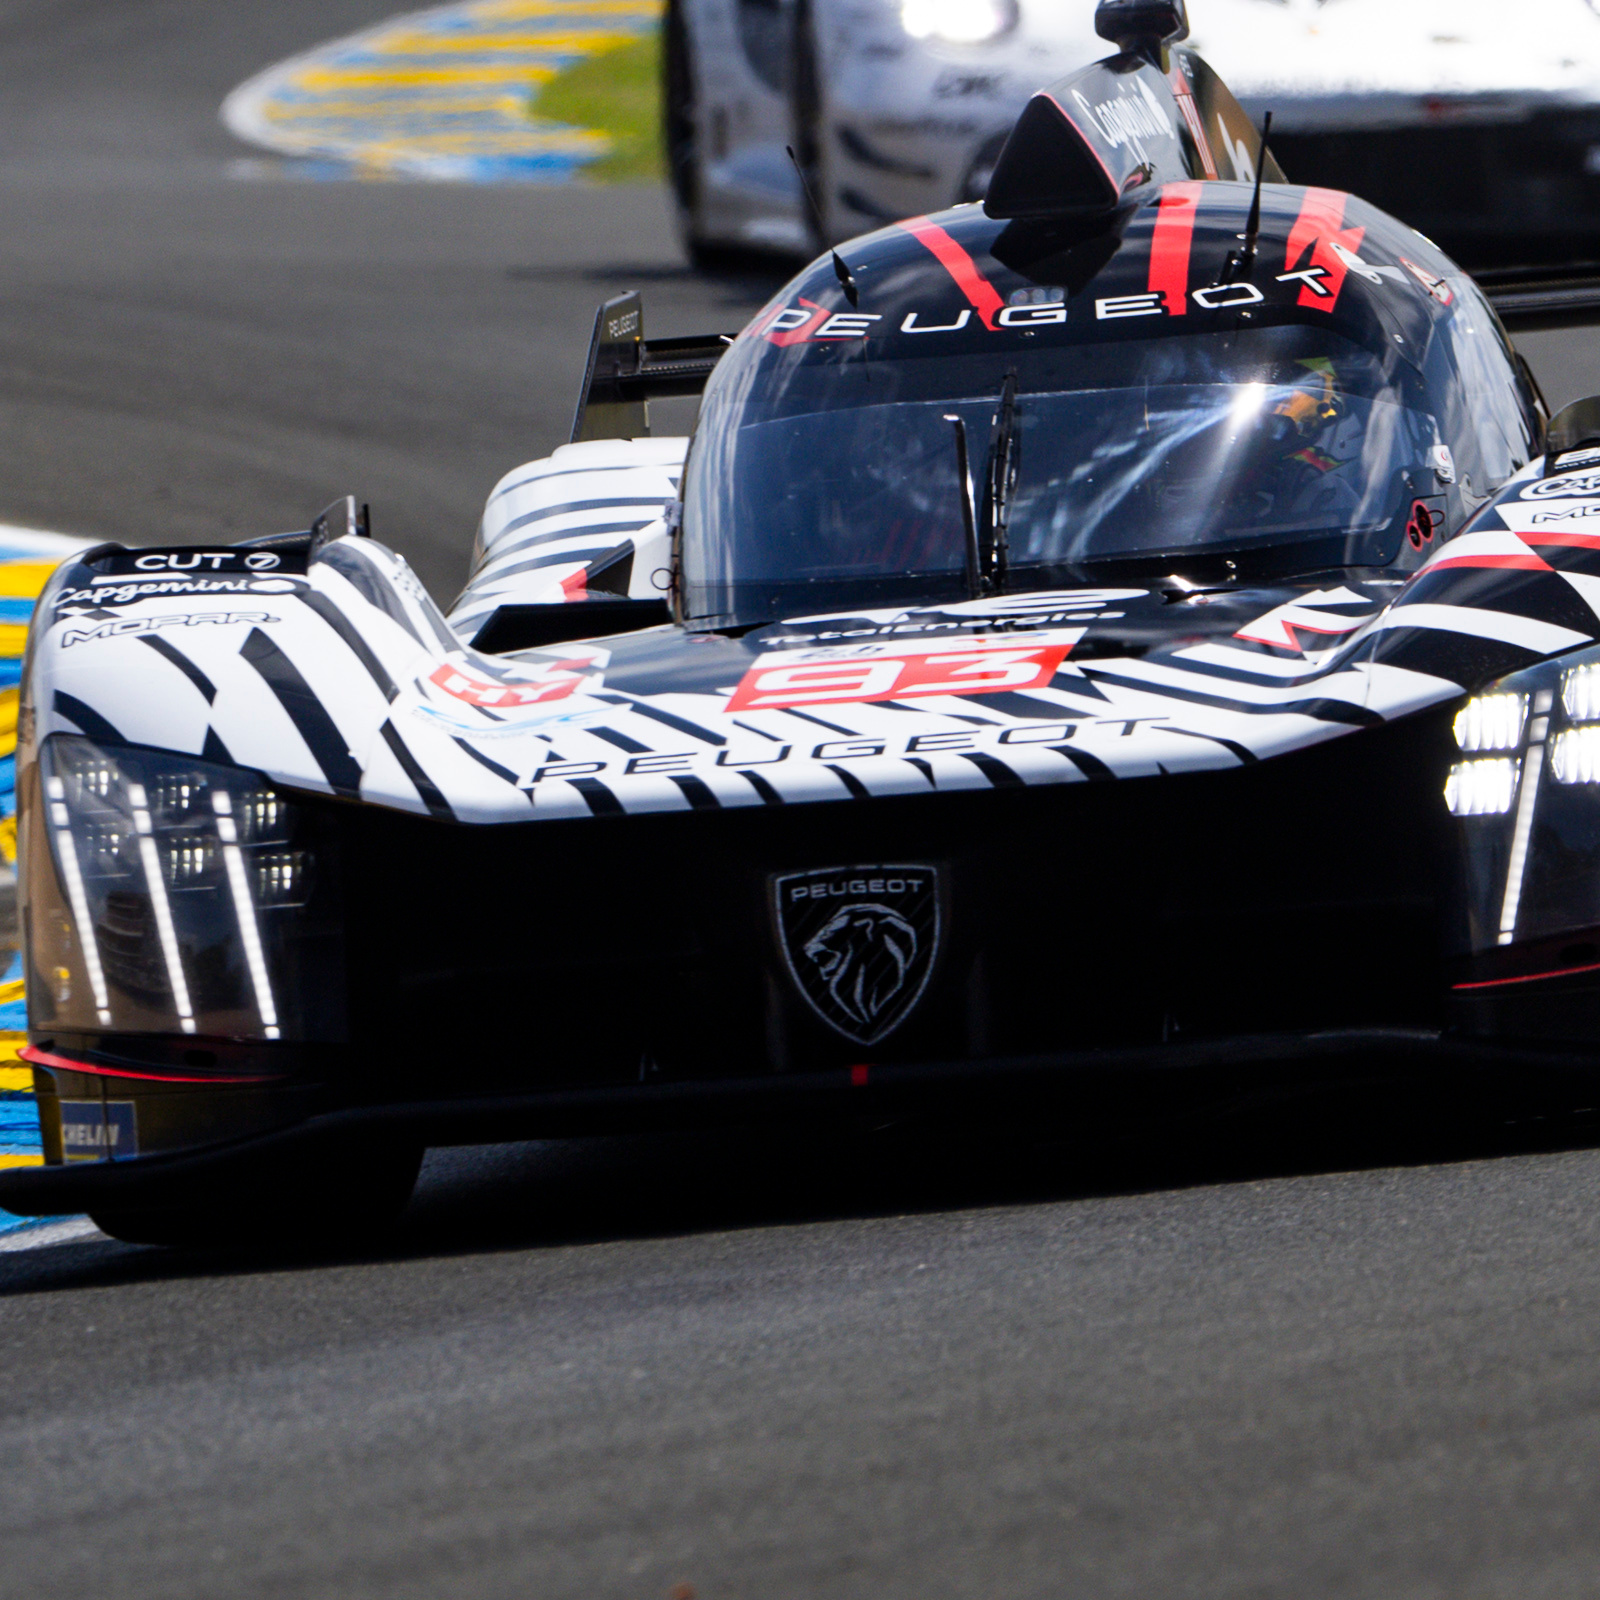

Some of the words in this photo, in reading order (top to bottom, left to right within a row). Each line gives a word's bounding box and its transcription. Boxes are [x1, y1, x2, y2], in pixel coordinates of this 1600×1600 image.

[761, 267, 1332, 337] PEUGEOT
[135, 553, 236, 570] CUT
[50, 578, 248, 609] Capgemini
[442, 673, 571, 704] HY
[746, 649, 1046, 706] 93
[531, 716, 1170, 783] PEUGEOT
[791, 879, 923, 901] PEUGEOT
